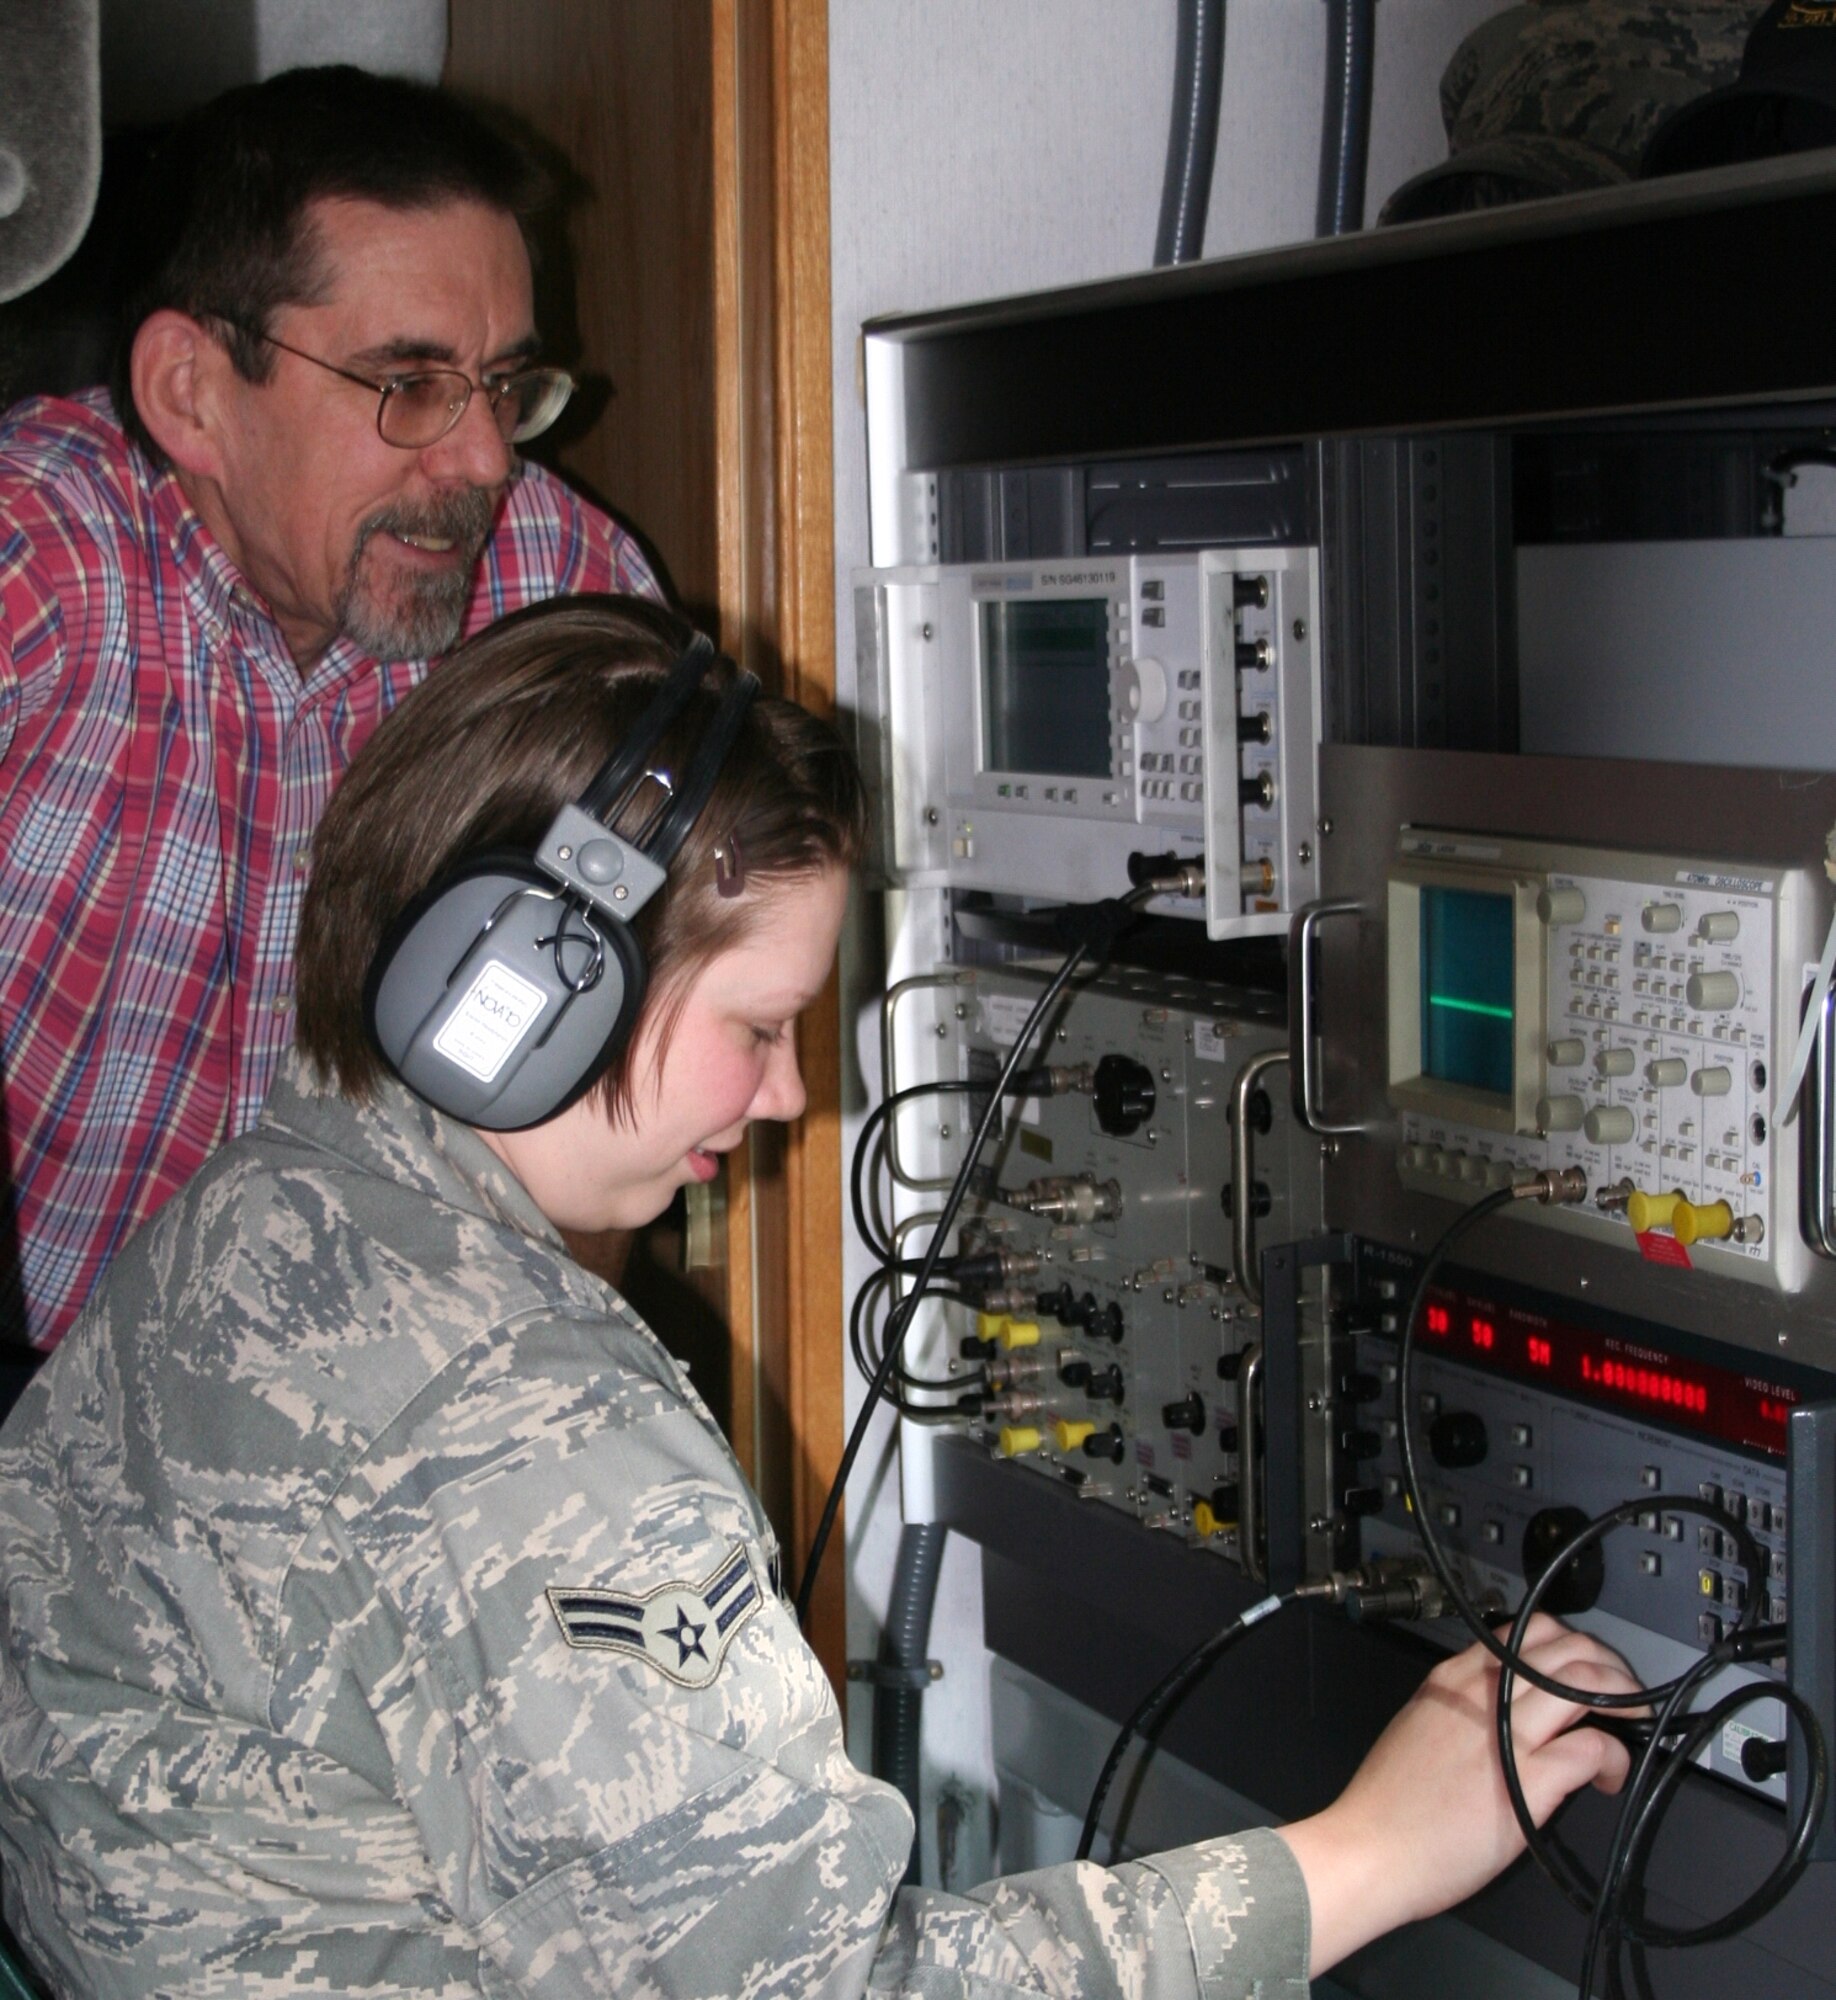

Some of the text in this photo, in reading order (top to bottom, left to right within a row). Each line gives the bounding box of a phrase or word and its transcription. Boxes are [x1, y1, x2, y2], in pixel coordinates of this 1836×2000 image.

[1716, 876, 1762, 891] OSCILLOSCOPE
[473, 989, 506, 1018] NOVA
[1625, 1344, 1668, 1364] FREQUENCY
[1744, 1376, 1796, 1402] VIDEO LEVEL
[1776, 1560, 1783, 1572] K
[1727, 1586, 1733, 1599] 2
